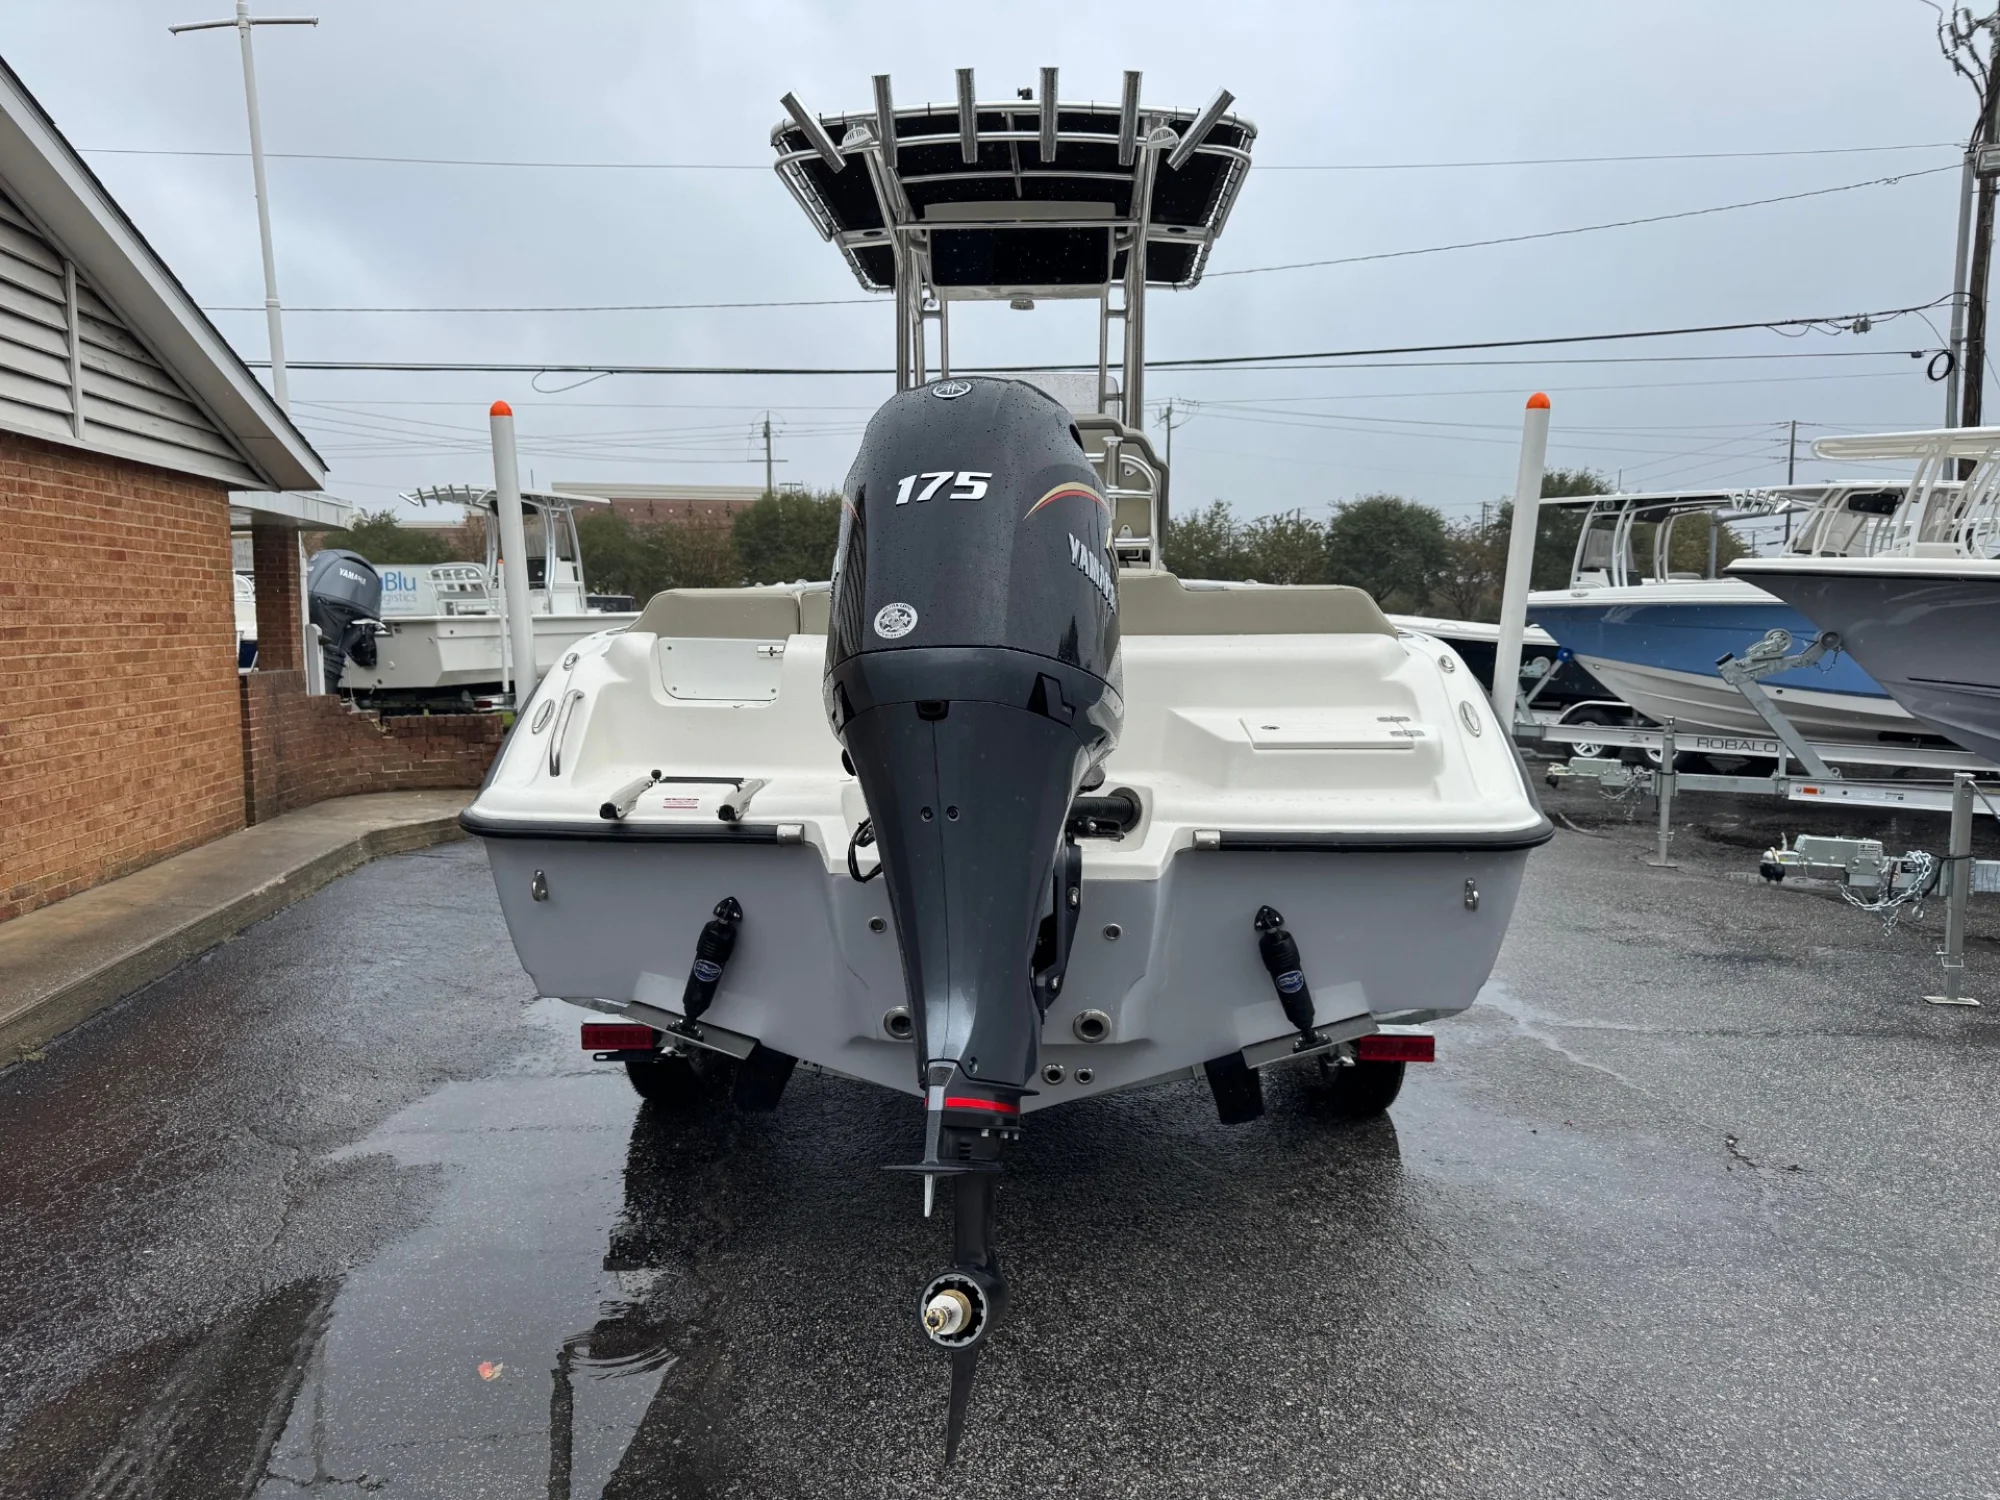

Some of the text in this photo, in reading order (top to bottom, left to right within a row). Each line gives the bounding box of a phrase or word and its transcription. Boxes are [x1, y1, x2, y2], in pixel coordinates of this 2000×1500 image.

[896, 471, 993, 505] 175
[381, 592, 418, 605] gistics
[1697, 737, 1778, 753] ROBALO
